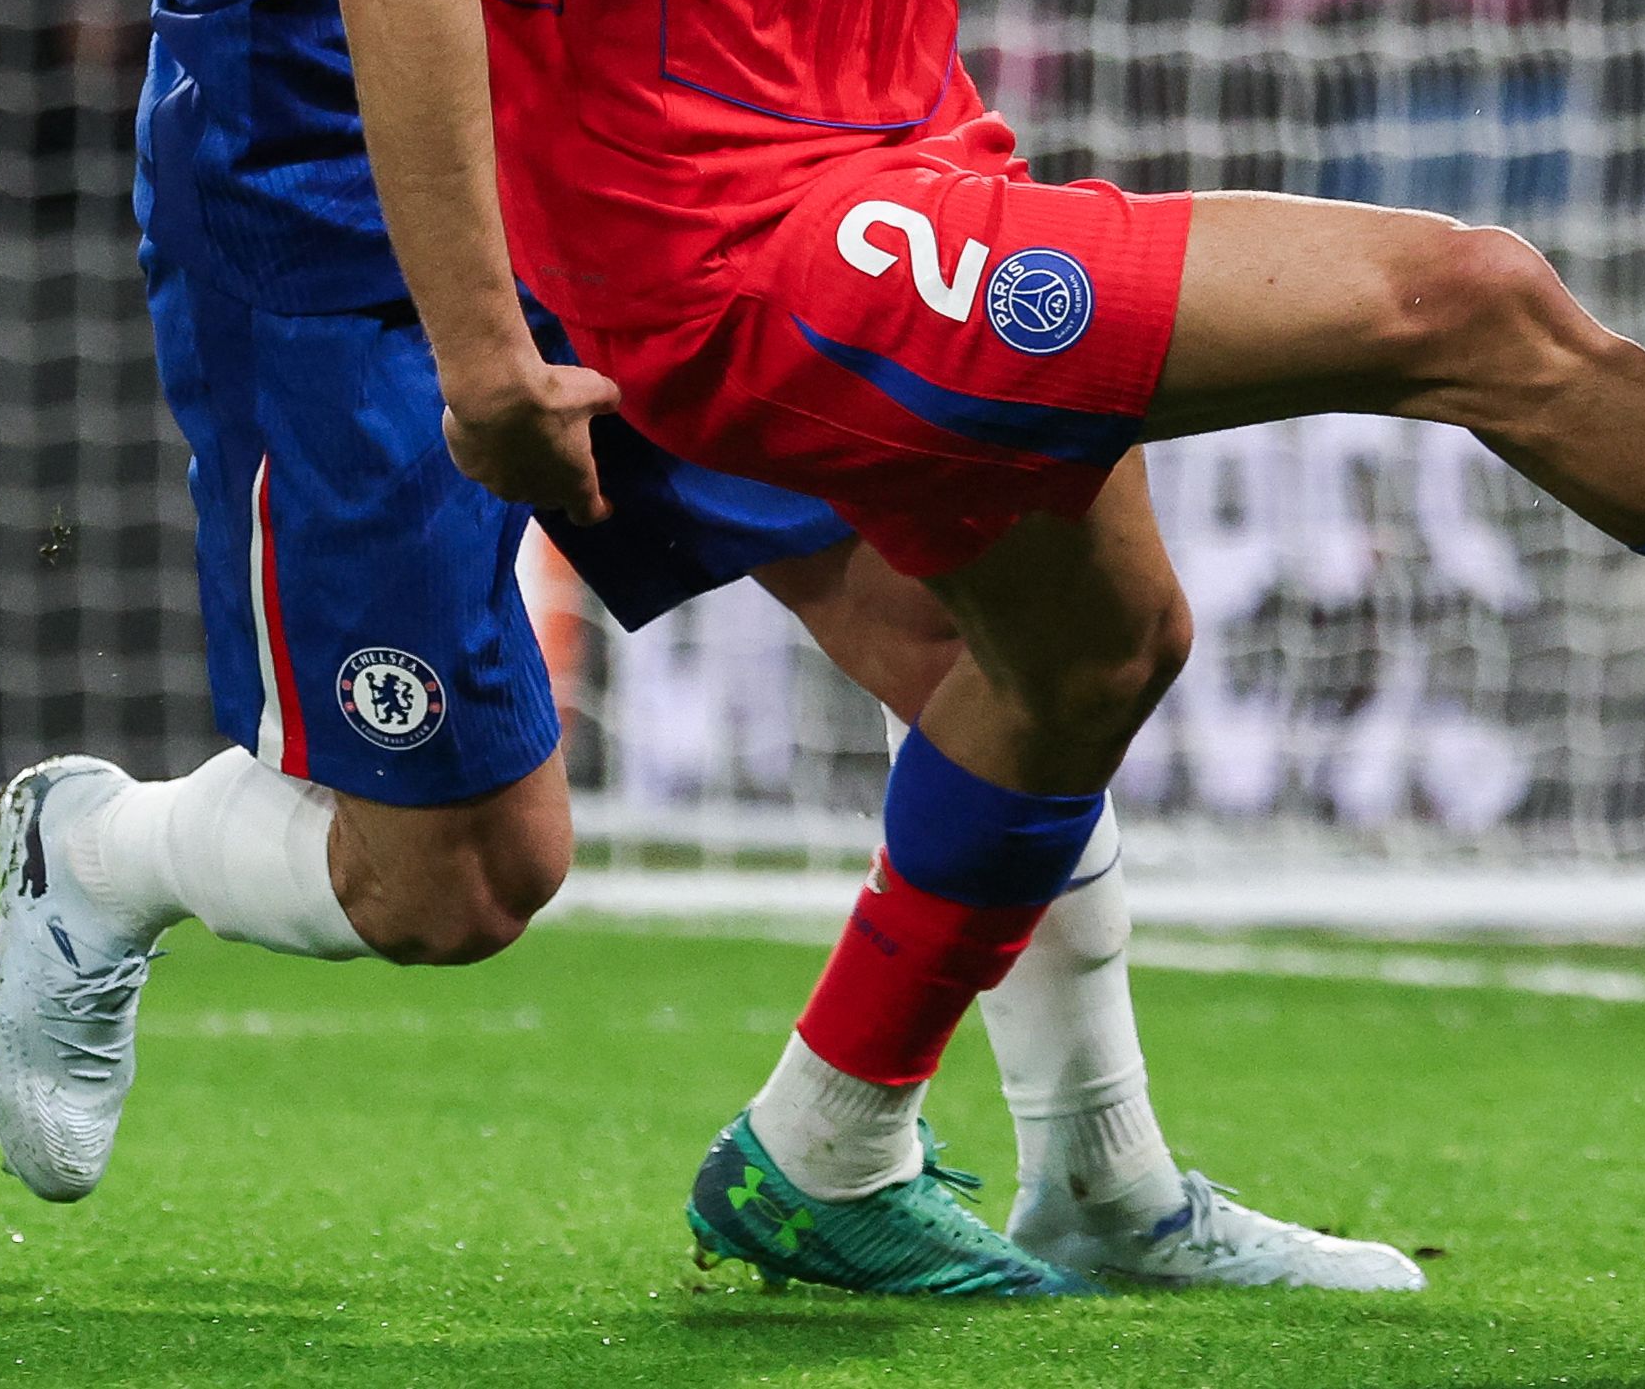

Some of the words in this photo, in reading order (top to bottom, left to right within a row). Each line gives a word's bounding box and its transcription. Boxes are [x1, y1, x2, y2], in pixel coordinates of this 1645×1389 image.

[836, 200, 990, 323] 2
[993, 261, 1025, 328] PARIS
[1068, 272, 1082, 314] GERMAIN
[351, 652, 417, 672] CHELSEA
